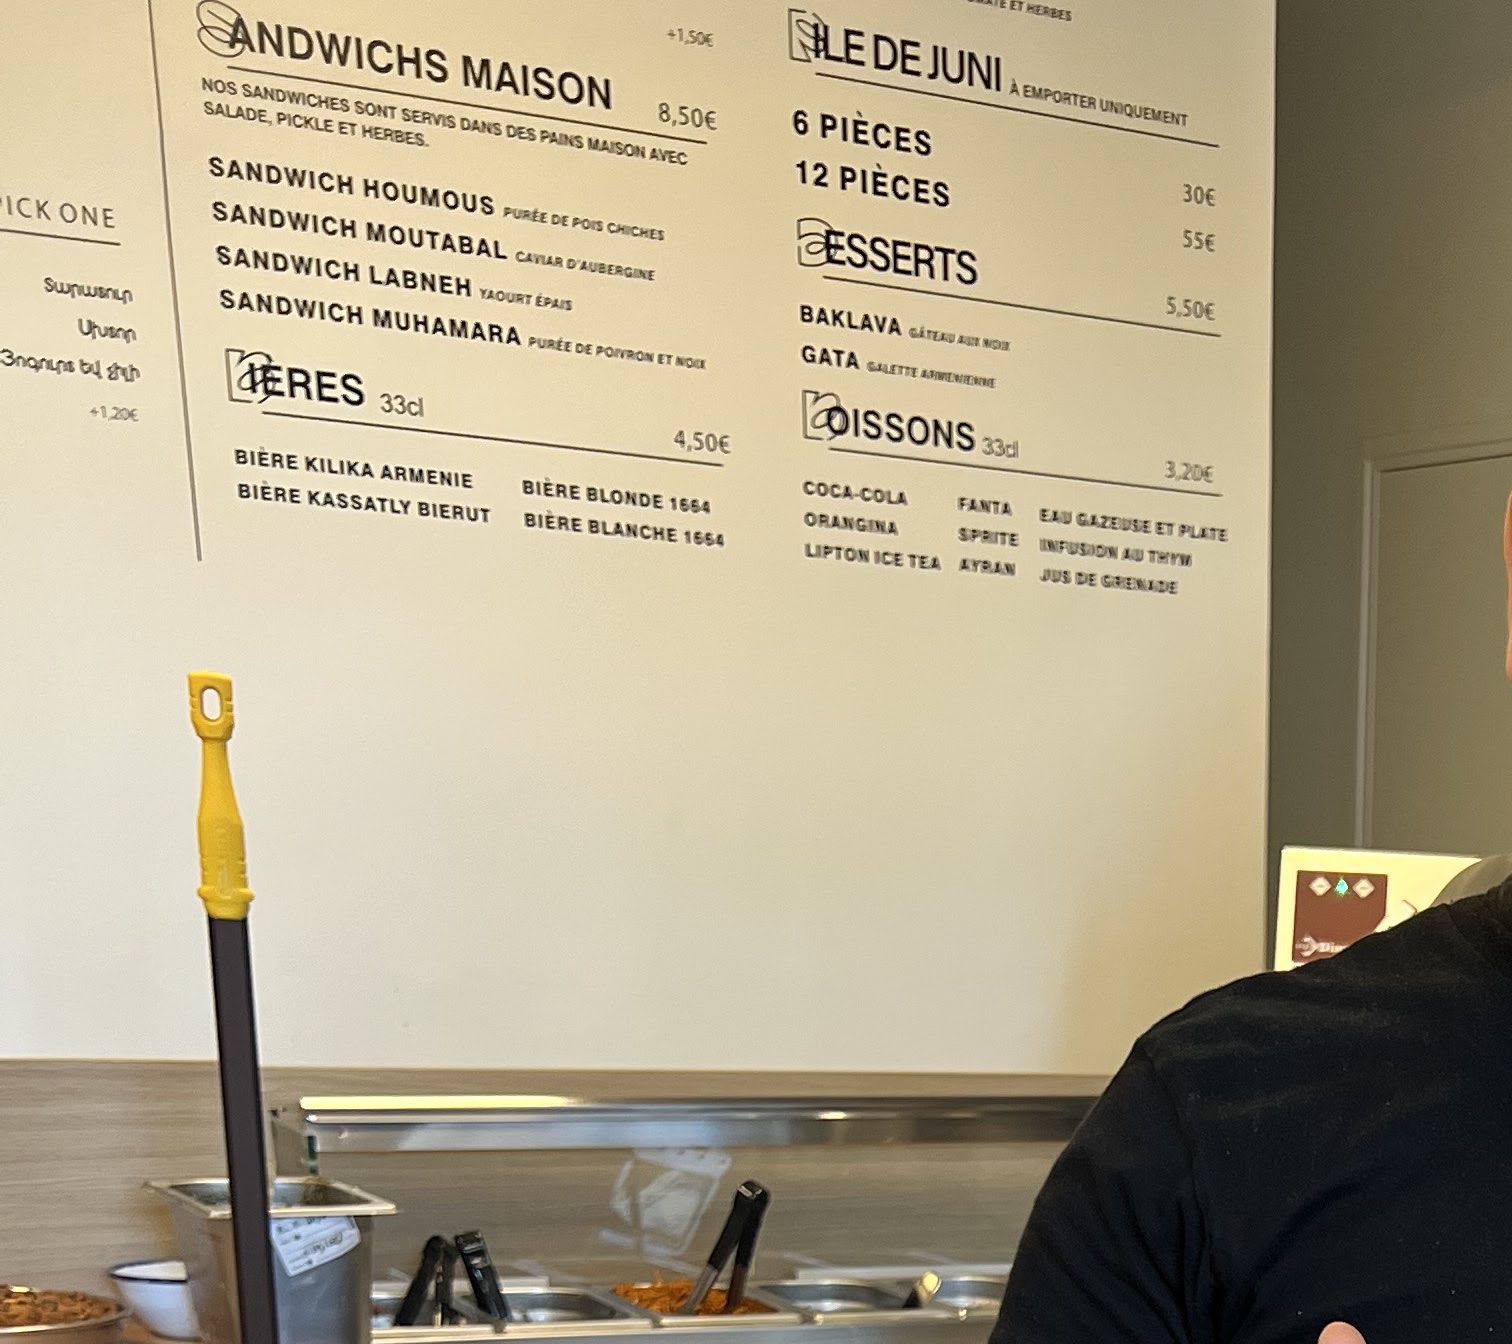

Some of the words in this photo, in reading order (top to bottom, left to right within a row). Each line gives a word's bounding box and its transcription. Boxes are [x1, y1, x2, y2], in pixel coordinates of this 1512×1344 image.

[1010, 1, 1024, 11] ET
[462, 54, 612, 110] MAISON
[873, 33, 922, 77] DE
[927, 45, 1001, 91] JUNI
[1023, 84, 1096, 110] EMPORTER
[1100, 99, 1188, 127] UNIQUEMENT
[202, 77, 237, 96] NOS
[241, 83, 350, 112] SANDWICHES
[354, 99, 397, 120] SONT
[402, 108, 456, 129] SERVIS
[460, 117, 502, 136] DANS
[506, 124, 537, 141] DES
[540, 130, 584, 149] PAINS
[588, 136, 646, 159] MAISON
[649, 147, 688, 165] AVEC
[204, 101, 273, 126] SALADE,
[277, 112, 334, 133] PICKLE
[338, 122, 357, 135] ET
[362, 126, 429, 148] HERBES.
[658, 102, 718, 130] 8,50€
[792, 110, 808, 135] 6
[820, 110, 932, 156] PIÈCES
[208, 156, 354, 195] SANDWICH
[363, 177, 495, 216] HOUMOUS
[551, 214, 569, 227] DE
[572, 217, 604, 232] POIS
[607, 223, 665, 241] CHICHES
[796, 160, 828, 187] 12
[840, 163, 950, 208] PIÈCES
[1183, 183, 1216, 207] 30€
[0, 195, 51, 221] ICK
[60, 203, 115, 228] ONE
[212, 201, 357, 238] SANDWICH
[366, 222, 508, 260] MOUTABAL
[515, 250, 563, 269] CAVIAR
[1183, 229, 1215, 252] 55€
[216, 245, 360, 282] SANDWICH
[369, 265, 472, 297] LABNEH
[479, 288, 532, 305] YAOURT
[219, 289, 363, 325] SANDWICH
[372, 308, 521, 346] MUHAMARA
[575, 343, 592, 355] DE
[658, 354, 673, 365] ET
[800, 305, 902, 336] BAKLAVA
[1166, 296, 1215, 321] 5,50€
[801, 345, 860, 370] GATA
[379, 393, 424, 417] 33cl
[673, 430, 731, 455] 4,50€
[981, 436, 1018, 458] 33cl
[234, 446, 298, 470] BIÈRE
[304, 456, 374, 479] KILIKA
[380, 465, 473, 489] ARMENIE
[1165, 460, 1214, 483] 3,20€
[237, 481, 301, 504] BIÈRE
[307, 490, 411, 515] KASSATLY
[417, 502, 491, 523] BIERUT
[522, 477, 580, 500] BIÈRE
[586, 487, 663, 509] BLONDE
[670, 497, 711, 514] 1664
[802, 481, 908, 505] COCA-COLA
[957, 497, 1013, 516] FANTA
[1039, 508, 1072, 524] EAU
[1076, 512, 1151, 534] GAZEUSE
[1156, 521, 1175, 536] ET
[1178, 524, 1229, 542] PLATE
[524, 510, 582, 532] BIÈRE
[588, 520, 677, 543] BLANCHE
[684, 530, 725, 547] 1664
[804, 512, 899, 536] ORANGINA
[958, 527, 1019, 547] SPRITE
[1039, 538, 1118, 559] INFUSION
[1122, 548, 1144, 562] AU
[804, 543, 870, 563] LIPTON
[874, 551, 904, 567] ICE
[909, 554, 942, 571] TEA
[959, 558, 1016, 576] AYRAN
[1040, 568, 1071, 583] JUS
[1075, 571, 1097, 587] DE
